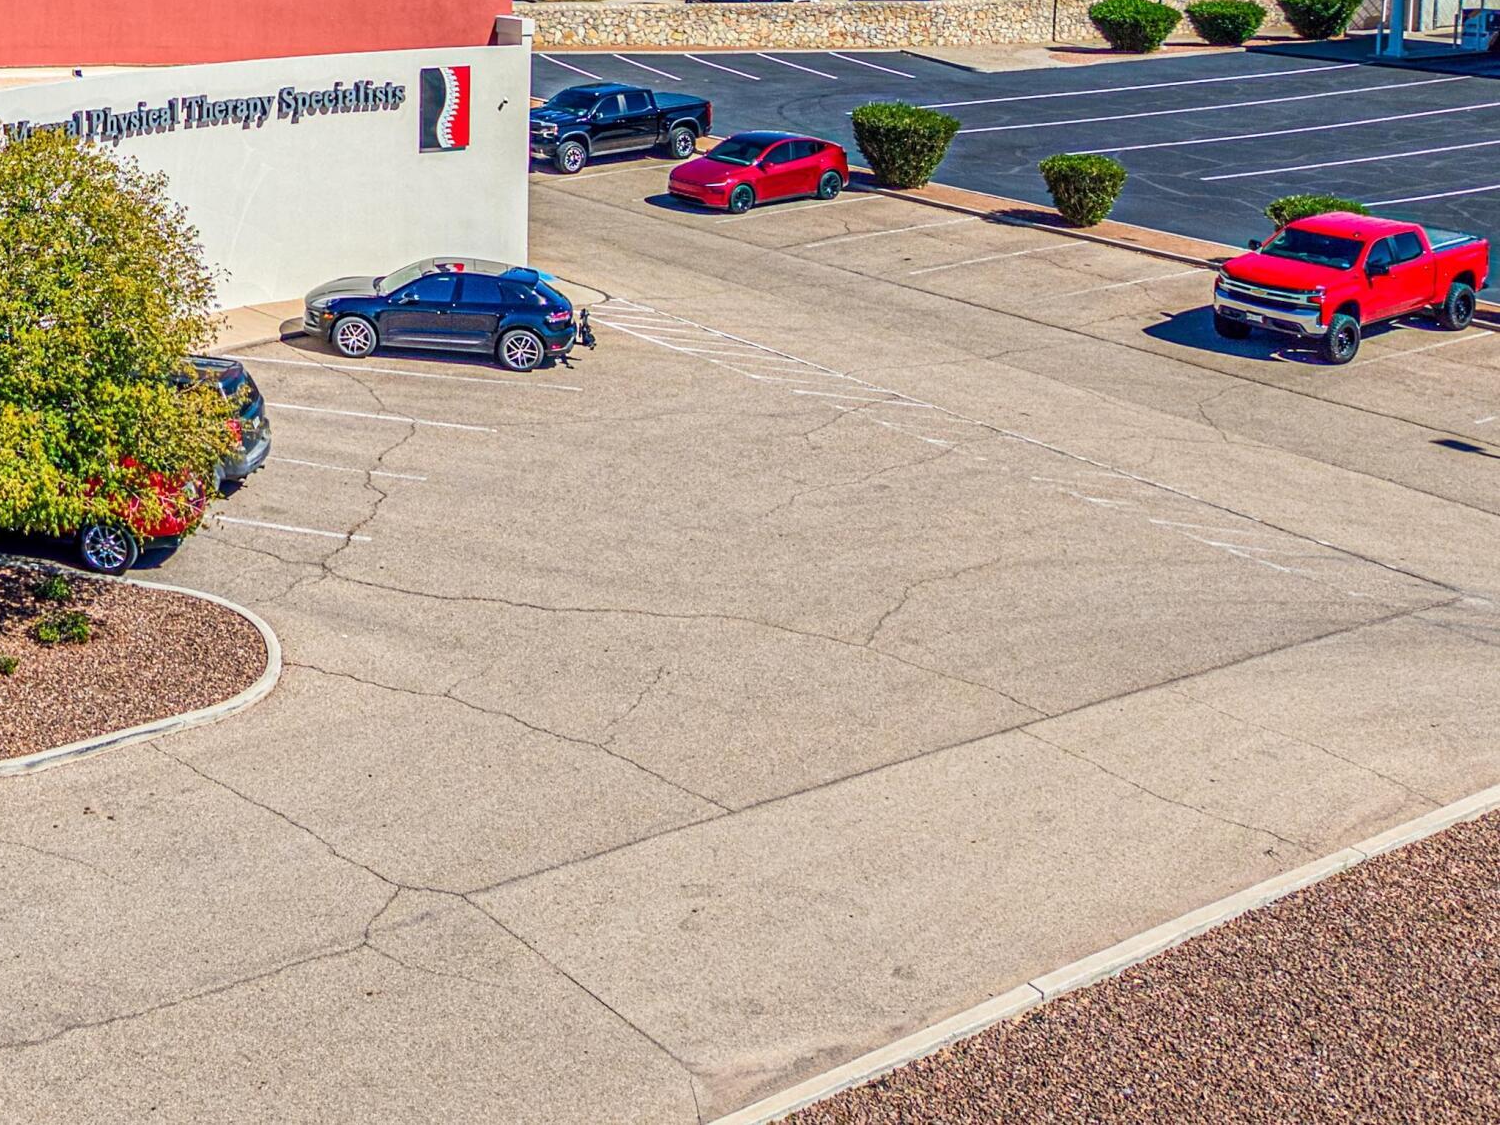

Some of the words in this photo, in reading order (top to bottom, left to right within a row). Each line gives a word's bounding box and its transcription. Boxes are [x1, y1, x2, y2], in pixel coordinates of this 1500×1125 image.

[86, 97, 180, 140] Physical
[183, 94, 275, 127] Therapy
[278, 80, 405, 121] Specialists
